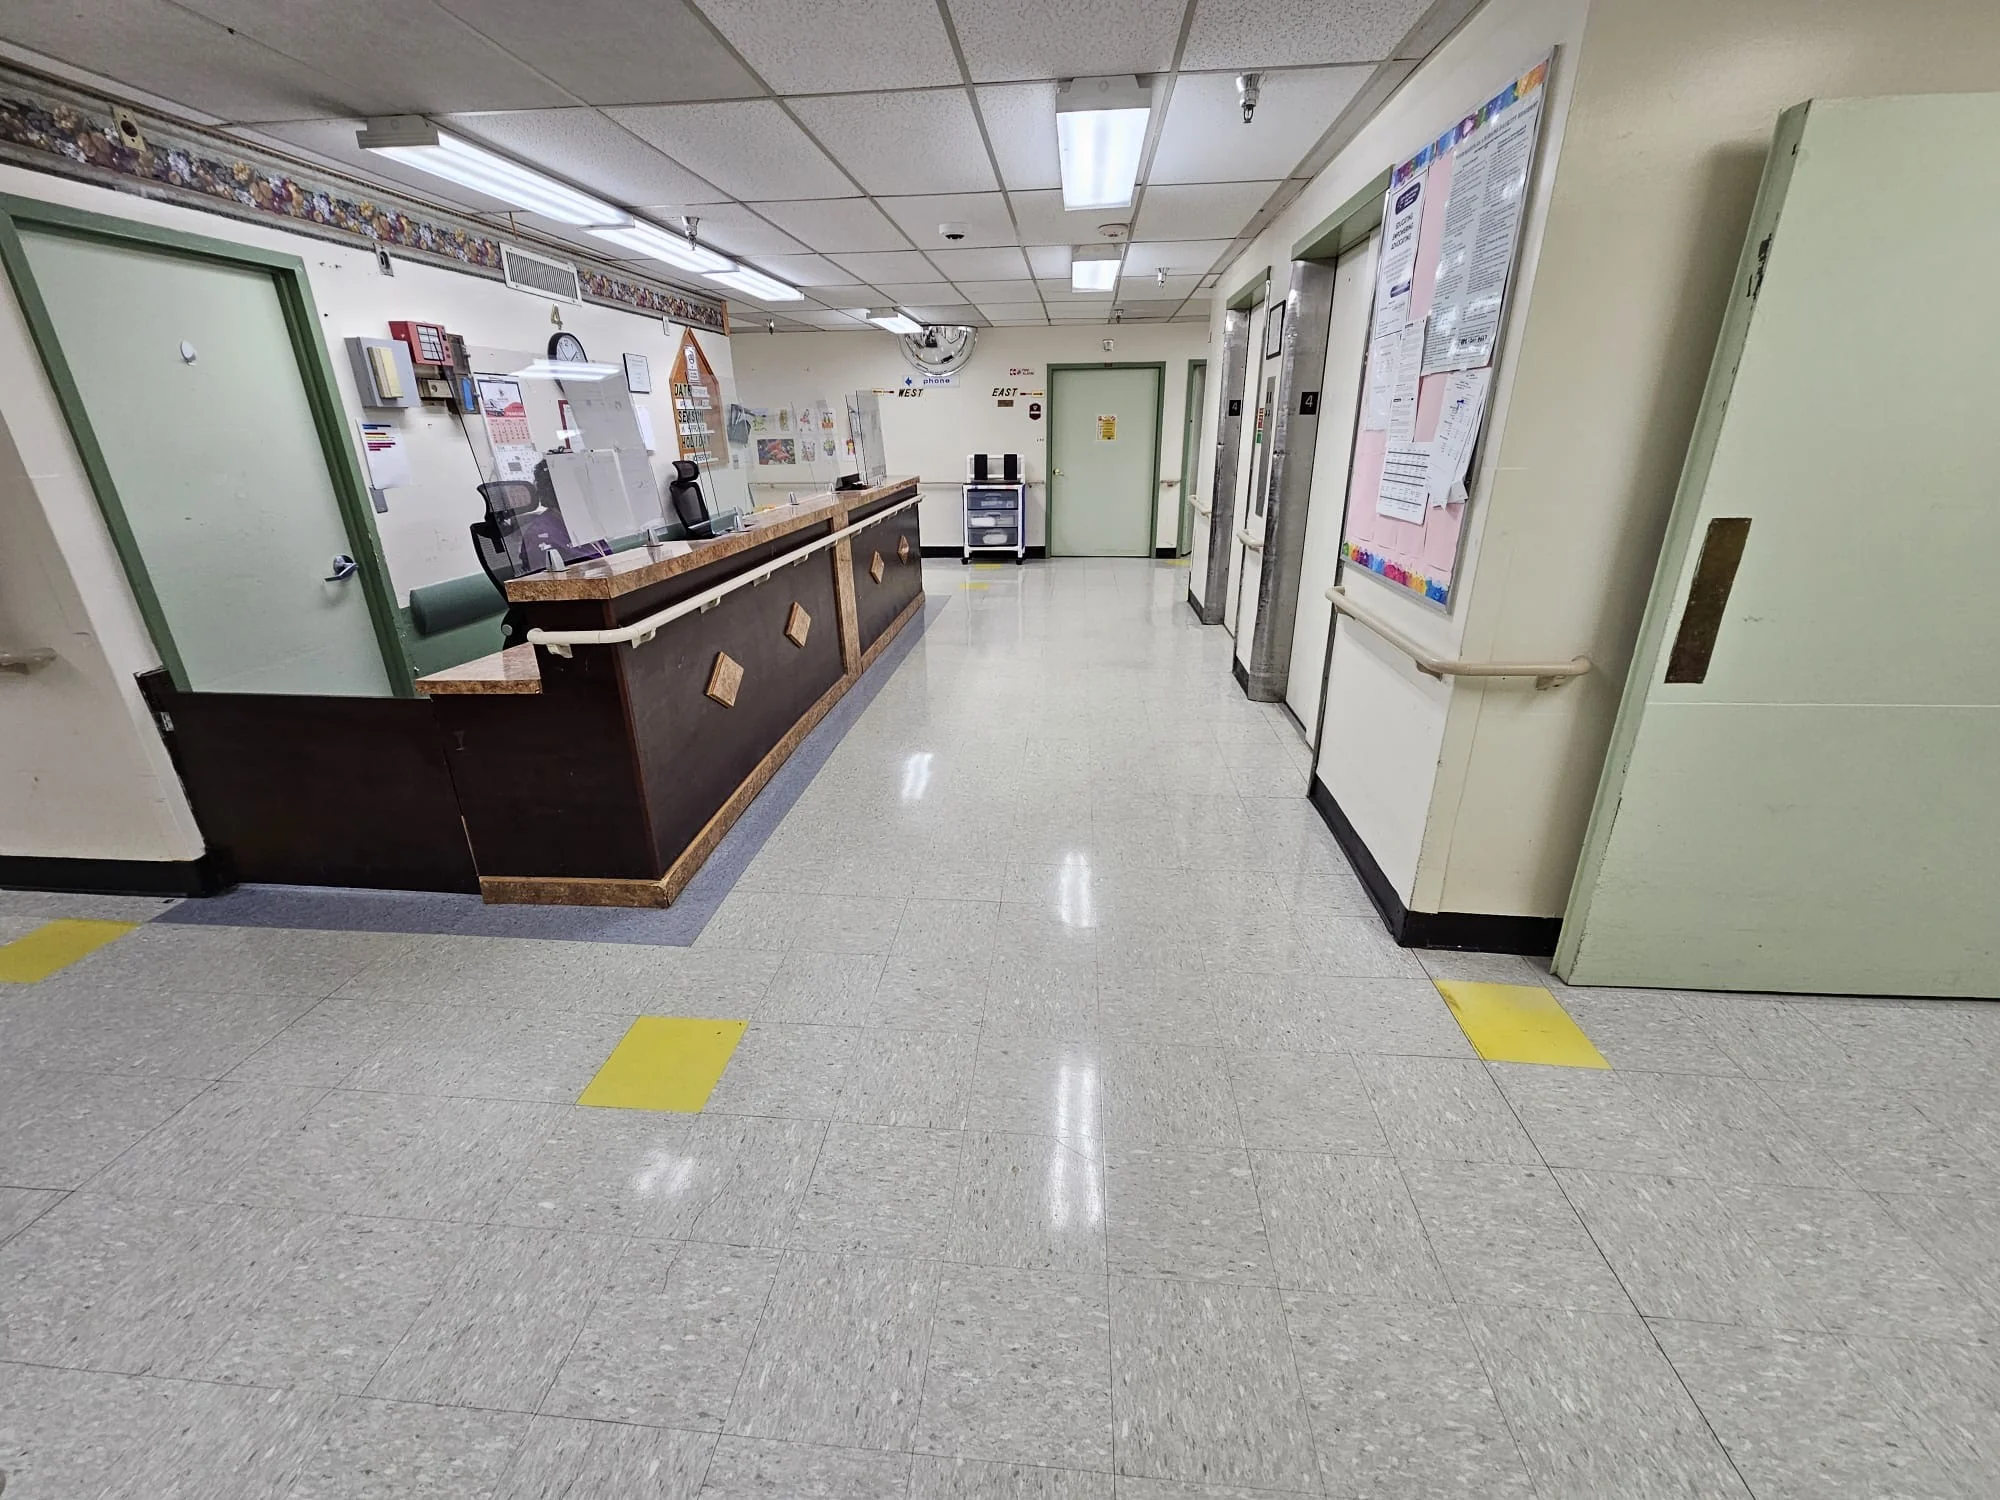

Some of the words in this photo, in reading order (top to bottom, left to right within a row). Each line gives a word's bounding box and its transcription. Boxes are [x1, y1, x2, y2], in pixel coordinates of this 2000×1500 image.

[550, 303, 563, 330] 4
[898, 388, 924, 398] WEST
[992, 387, 1018, 397] EAST
[1231, 402, 1238, 410] 4
[1305, 395, 1313, 407] 4
